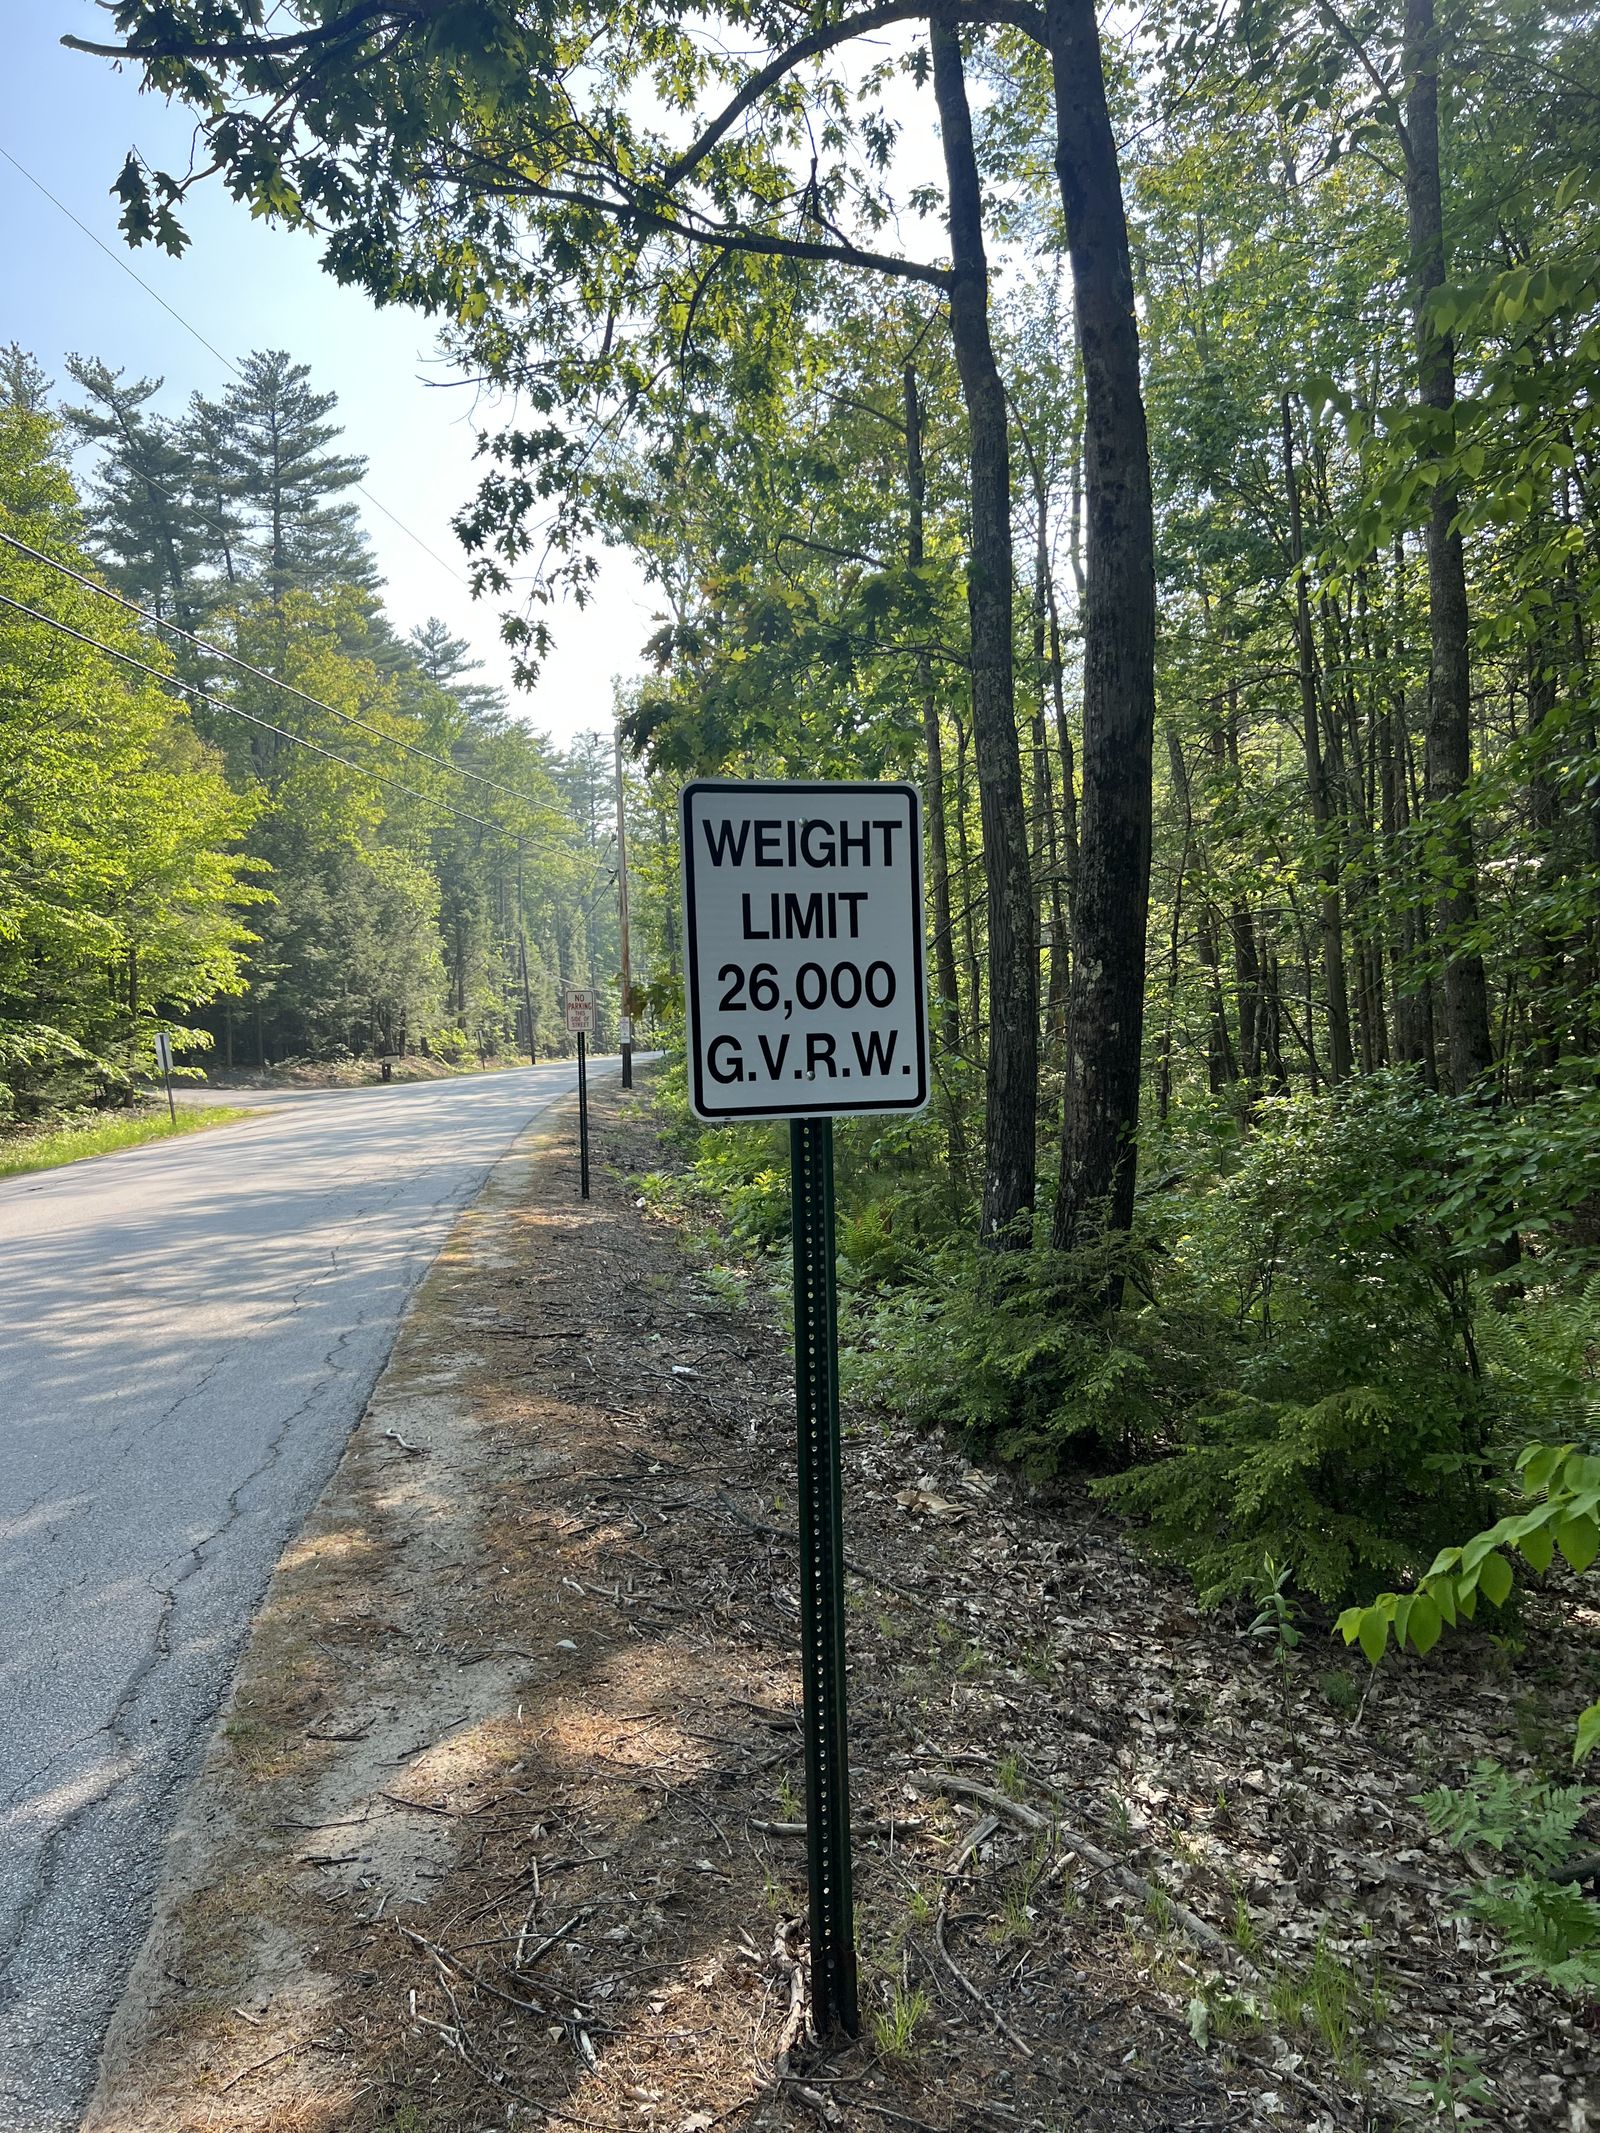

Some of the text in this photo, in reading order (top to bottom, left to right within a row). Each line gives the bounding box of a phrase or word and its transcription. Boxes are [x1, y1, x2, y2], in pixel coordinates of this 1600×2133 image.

[702, 819, 903, 868] WEIGHT
[742, 892, 868, 940] LIMIT
[568, 1002, 592, 1010] PARKING
[574, 994, 585, 1002] NO
[717, 960, 897, 1020] 26,000
[707, 1030, 911, 1084] G.V.R.W.
